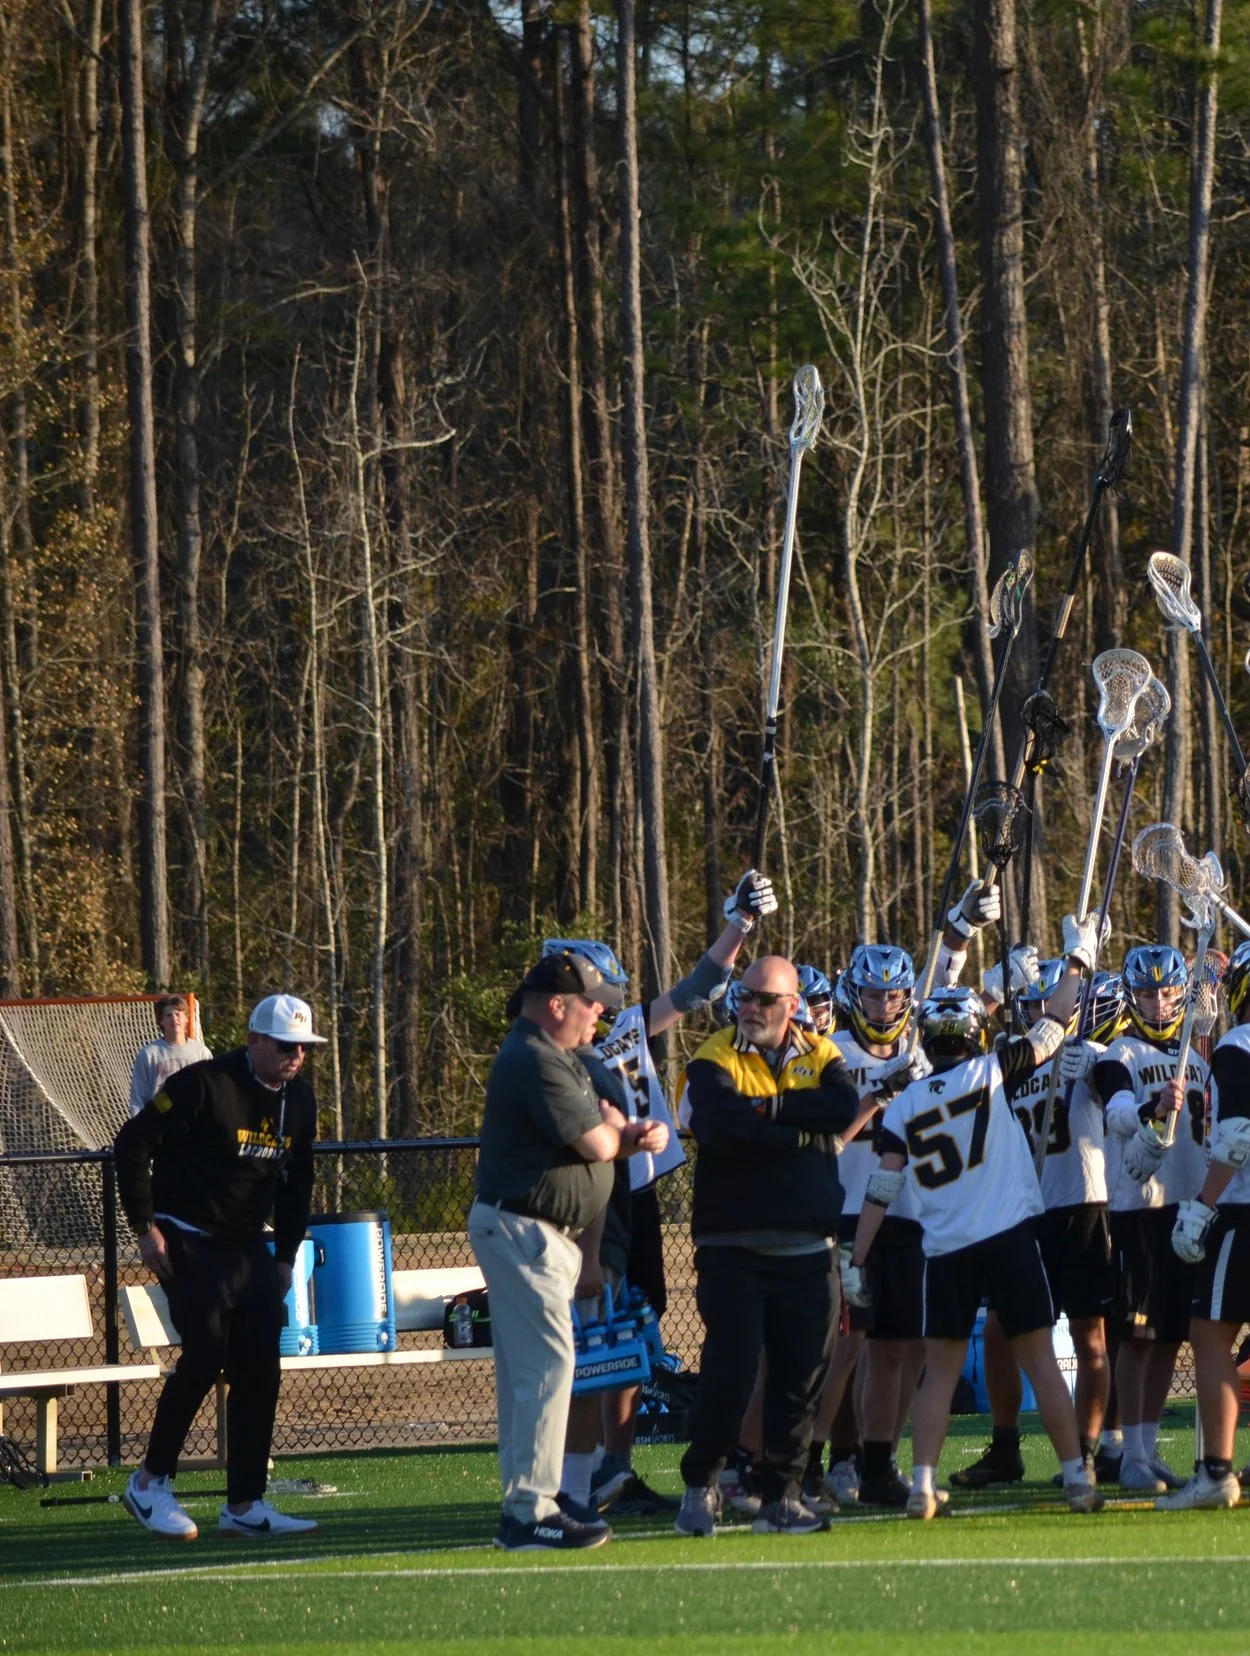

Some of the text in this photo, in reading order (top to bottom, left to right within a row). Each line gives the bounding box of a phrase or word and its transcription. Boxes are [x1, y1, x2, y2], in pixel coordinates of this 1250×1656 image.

[905, 1084, 990, 1191] 57
[375, 1227, 388, 1314] POWERADE
[575, 1356, 639, 1379] POWERADE
[533, 1525, 564, 1539] HOKA
